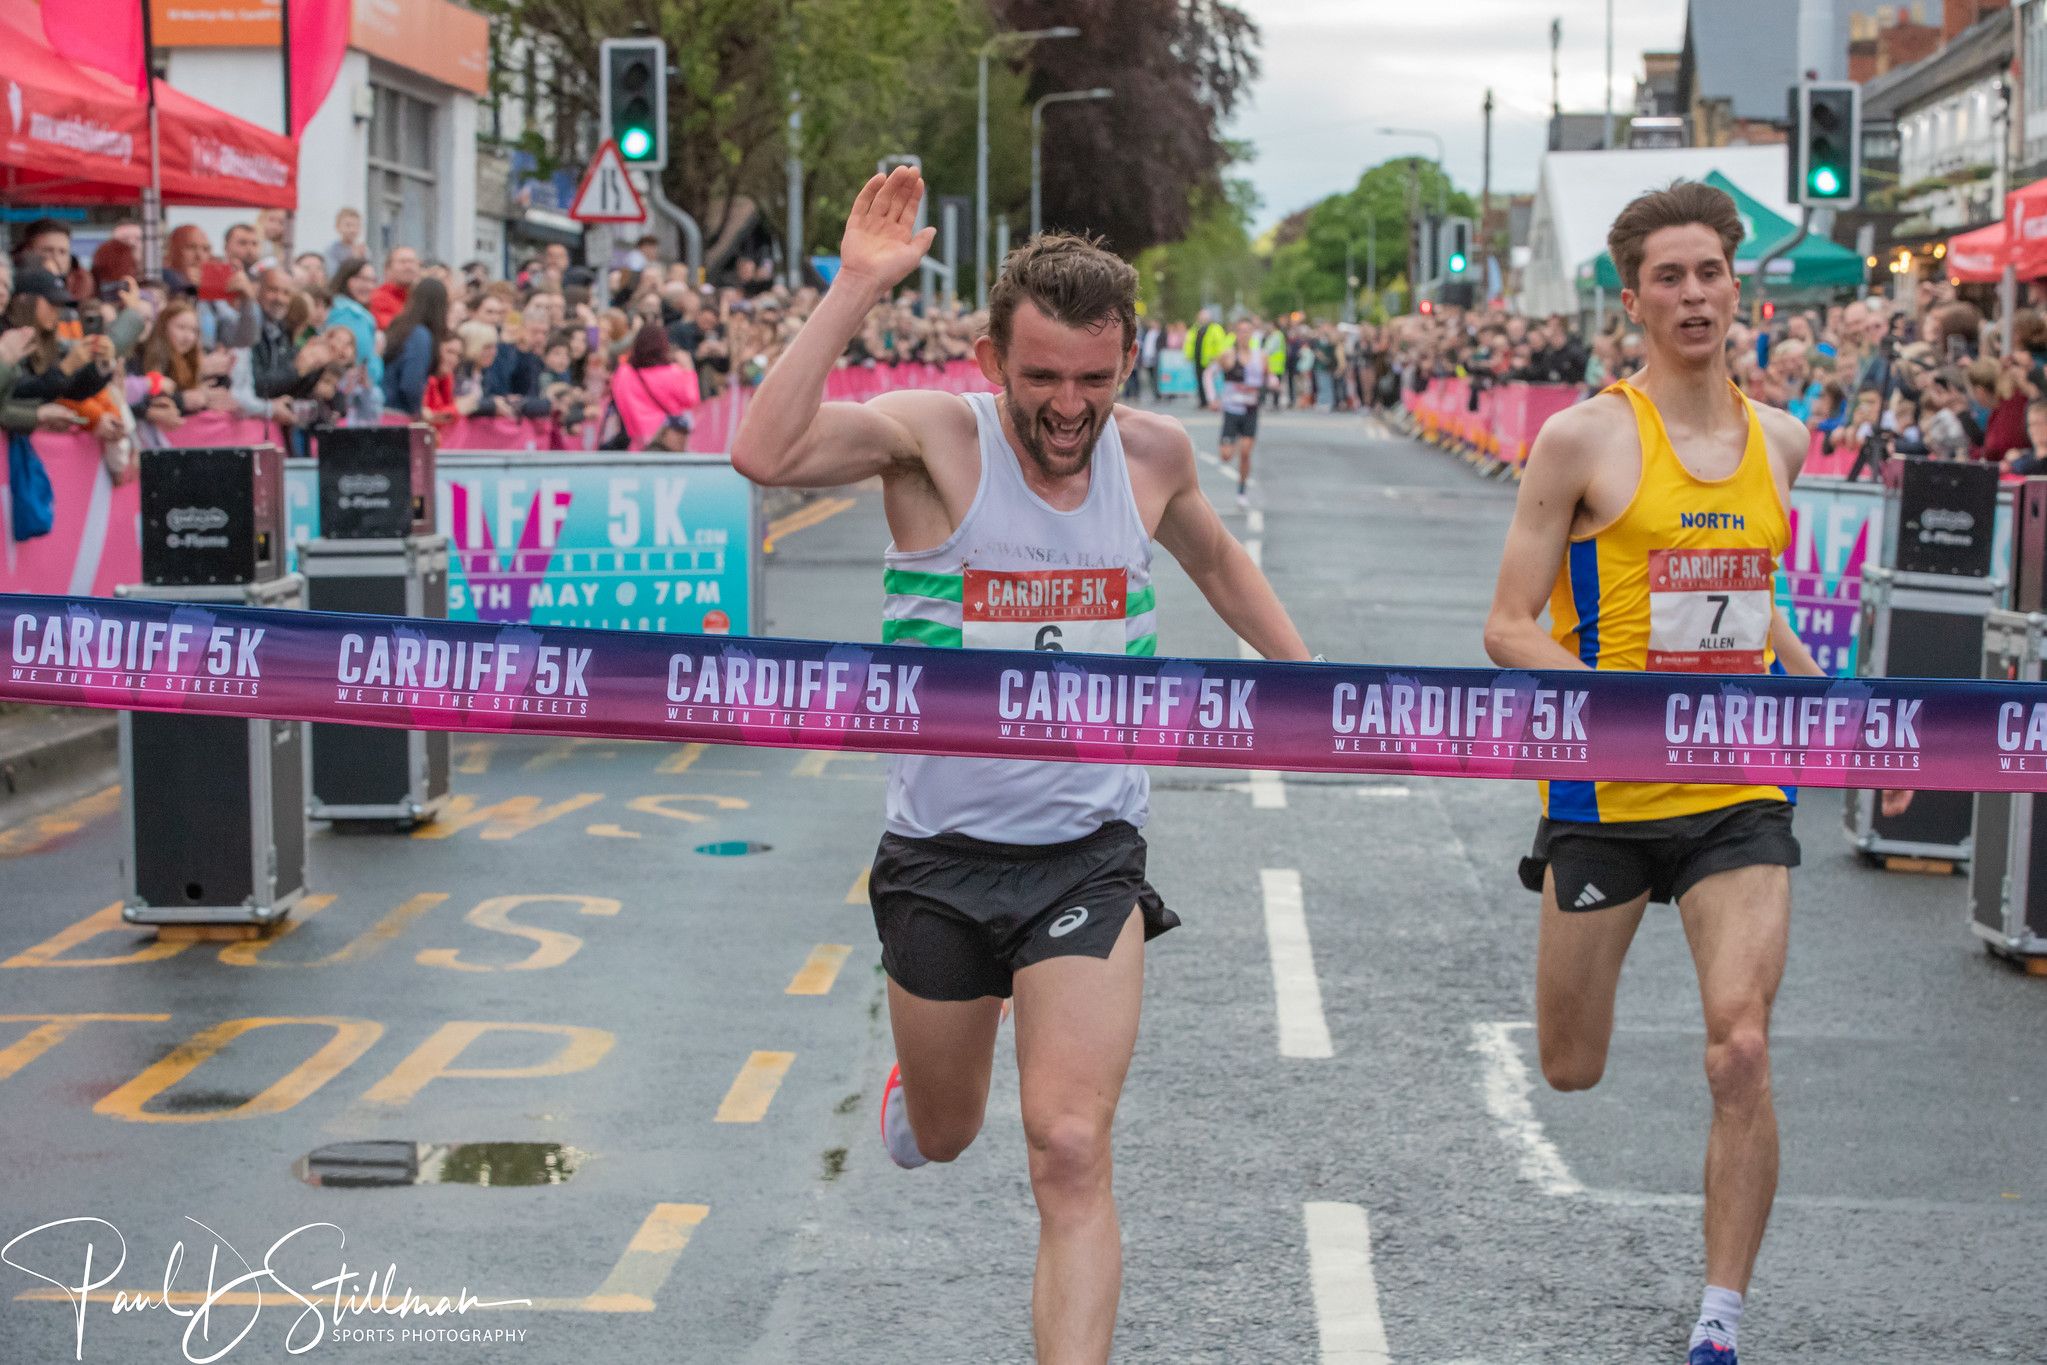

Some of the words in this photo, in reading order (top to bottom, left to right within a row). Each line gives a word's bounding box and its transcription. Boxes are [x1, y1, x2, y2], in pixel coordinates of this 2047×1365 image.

[607, 477, 688, 547] 5K
[1680, 512, 1745, 530] NORTH
[1668, 555, 1738, 581] CARDIFF
[1742, 555, 1761, 578] 5K
[528, 582, 600, 607] MAY
[654, 580, 720, 605] 7PM
[987, 578, 1073, 607] CARDIFF
[1081, 577, 1108, 605] 5K
[1707, 595, 1729, 635] 7
[12, 614, 193, 672] CARDIFF
[207, 627, 265, 677] 5K
[1699, 637, 1735, 650] ALLEN
[337, 633, 520, 692] CARDIFF
[535, 646, 593, 697] 5K
[12, 669, 37, 681] WE
[55, 671, 92, 685] RUN
[112, 674, 146, 688] THE
[165, 677, 258, 695] STREETS
[666, 653, 850, 710] CARDIFF
[866, 664, 923, 715] 5K
[338, 688, 362, 701] WE
[382, 691, 419, 704] RUN
[438, 694, 473, 708] THE
[493, 697, 587, 715] STREETS
[998, 669, 1182, 726] CARDIFF
[1199, 678, 1256, 729] 5K
[1332, 682, 1516, 738] CARDIFF
[1532, 689, 1590, 740] 5K
[668, 707, 692, 721] WE
[712, 709, 750, 724] RUN
[769, 712, 805, 726] THE
[824, 715, 919, 732] STREETS
[1665, 693, 1849, 746] CARDIFF
[1865, 698, 1923, 748] 5K
[1001, 724, 1026, 737] WE
[1046, 726, 1083, 740] RUN
[1103, 729, 1139, 742] THE
[1158, 732, 1253, 747] STREETS
[1335, 738, 1360, 751] WE
[1380, 740, 1417, 752] RUN
[1436, 742, 1472, 755] THE
[1493, 744, 1587, 759] STREETS
[1668, 750, 1693, 762] WE
[1713, 751, 1750, 764] RUN
[1770, 752, 1806, 765] THE
[1825, 754, 1920, 768] STREETS
[2000, 758, 2025, 770] WE
